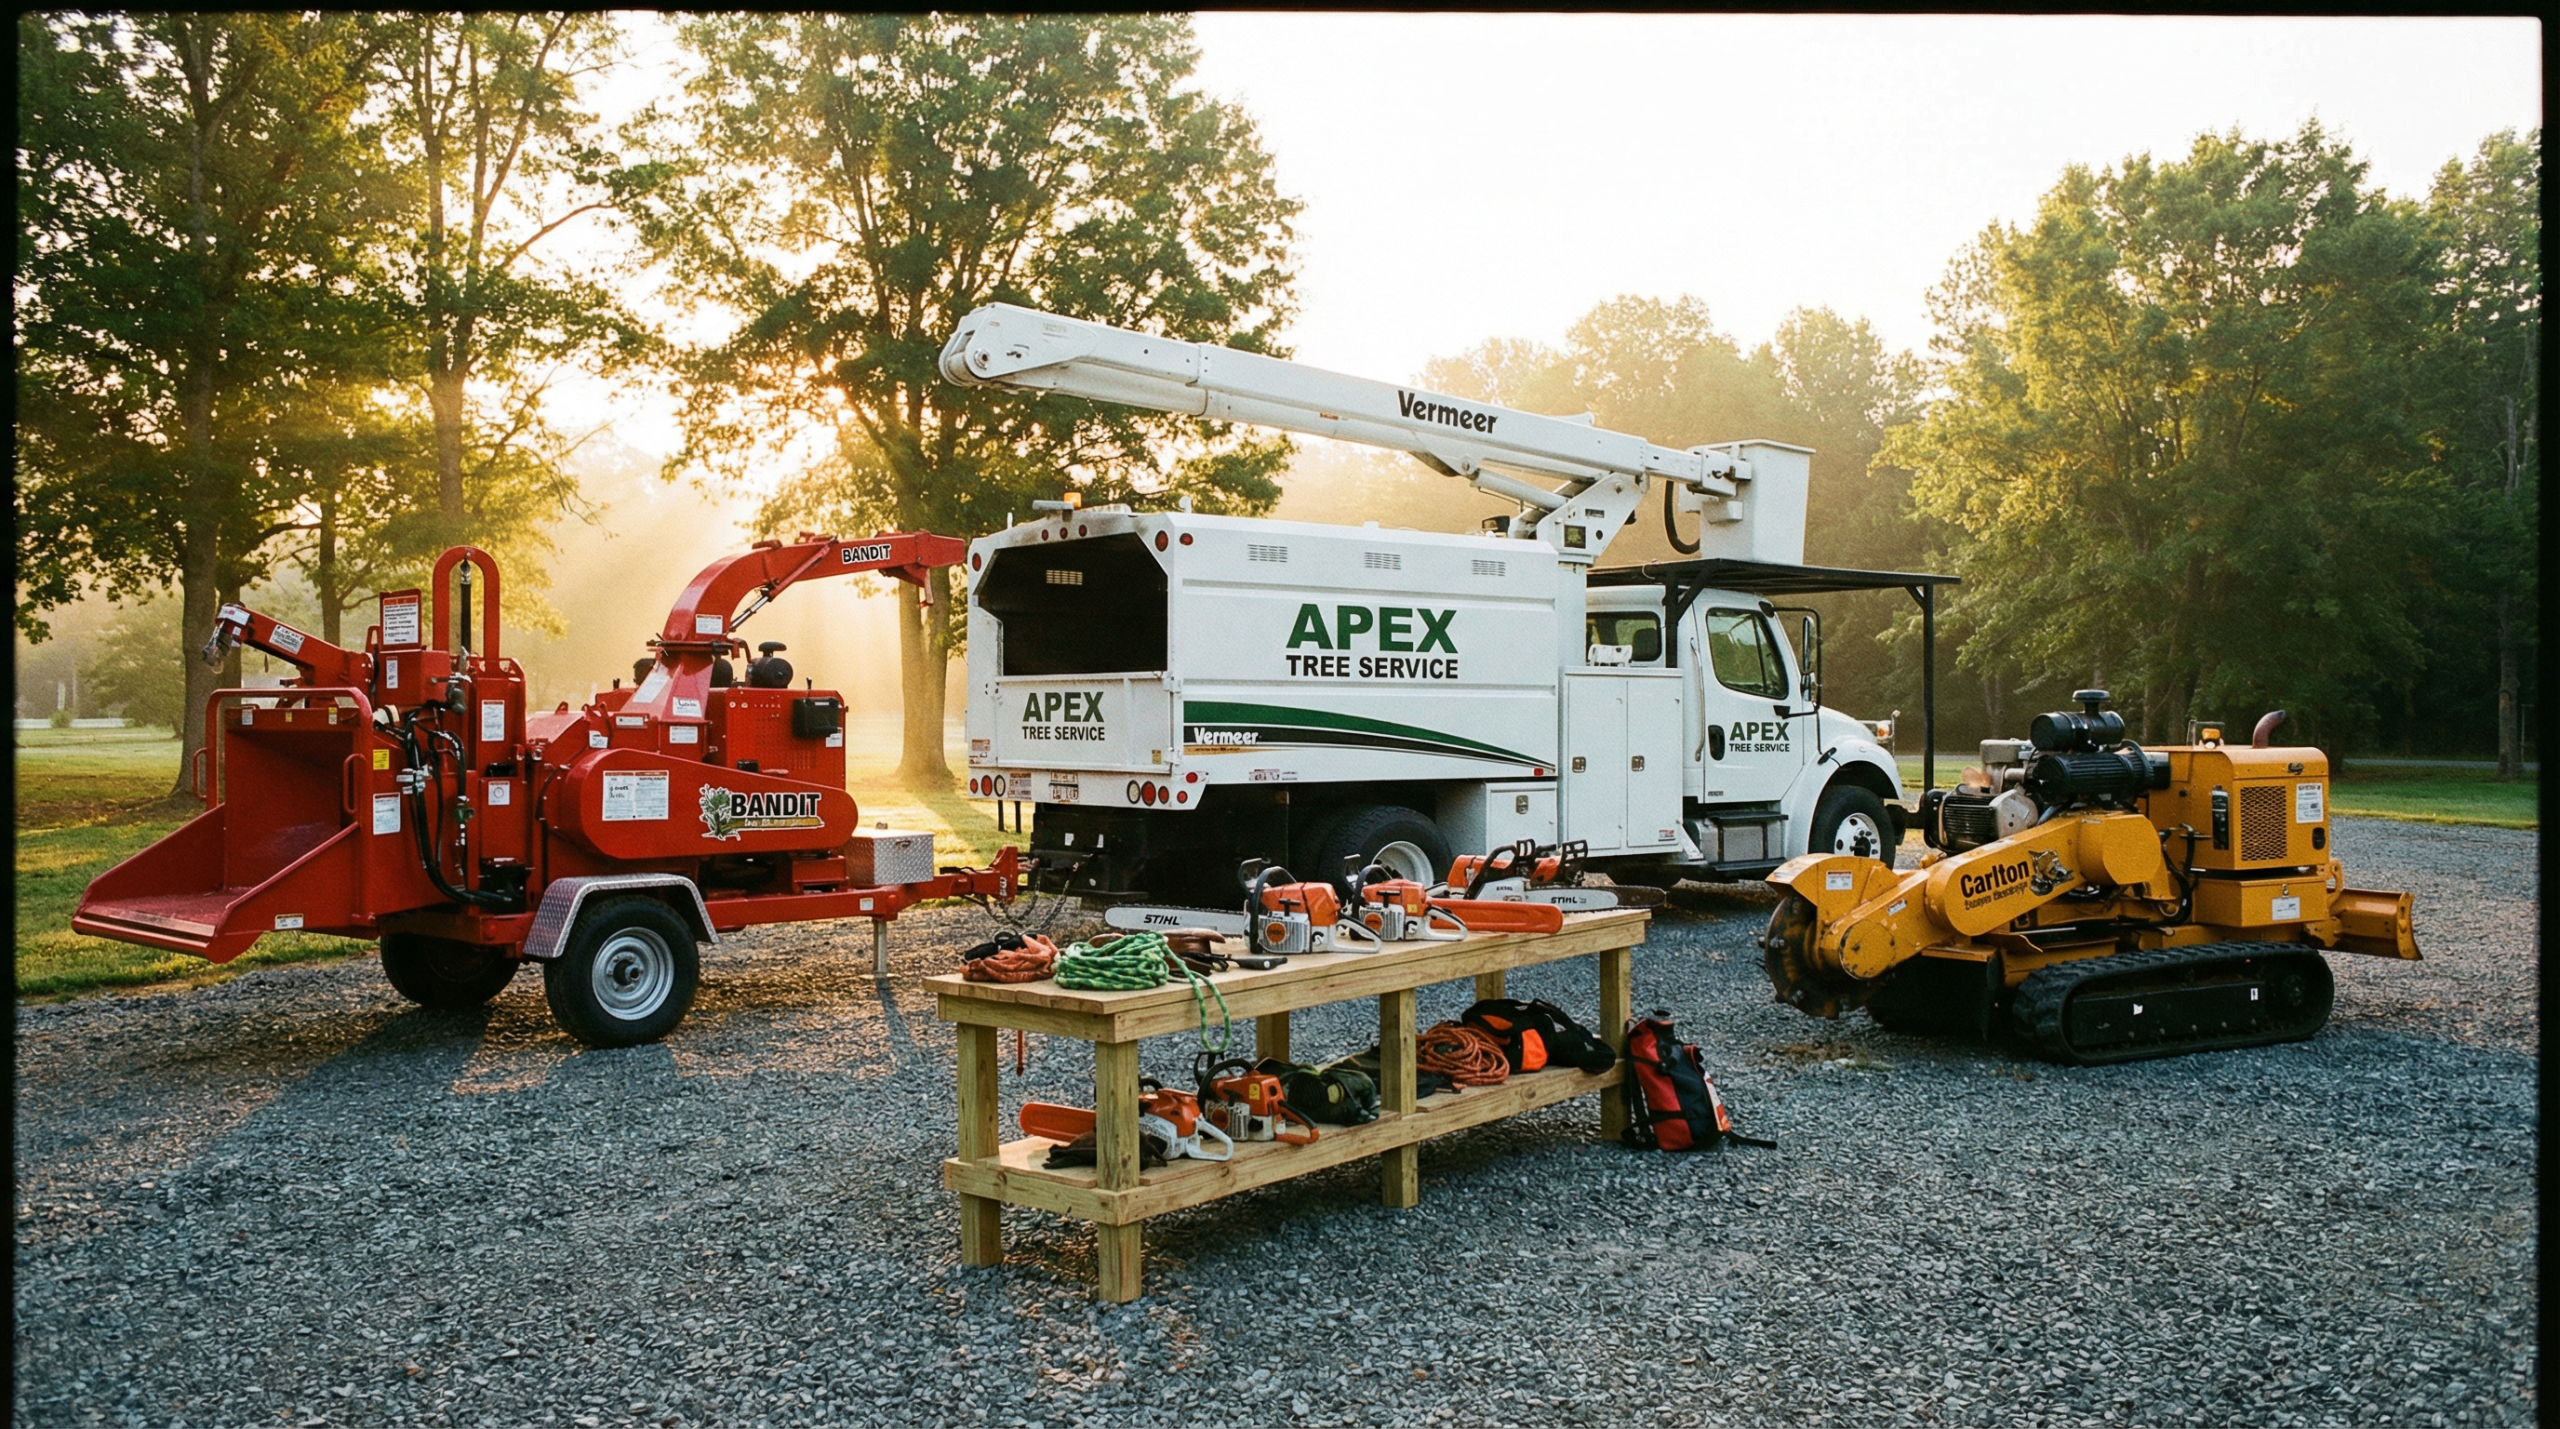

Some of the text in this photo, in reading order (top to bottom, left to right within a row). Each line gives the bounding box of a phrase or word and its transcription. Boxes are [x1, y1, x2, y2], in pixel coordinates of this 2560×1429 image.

[1398, 390, 1498, 434] Vermeer
[842, 544, 891, 563] BANDIT
[1286, 603, 1459, 654] APEX
[1286, 655, 1459, 679] TREE SERVICE
[1022, 691, 1105, 723] APEX
[1022, 726, 1105, 741] TREE SERVICE
[1193, 727, 1259, 745] Vermeer
[1729, 721, 1790, 741] APEX
[1729, 743, 1790, 753] TREE SERVICE
[731, 793, 820, 817] BANDIT
[1960, 861, 2030, 899] Carlton
[1143, 914, 1180, 926] STIHL
